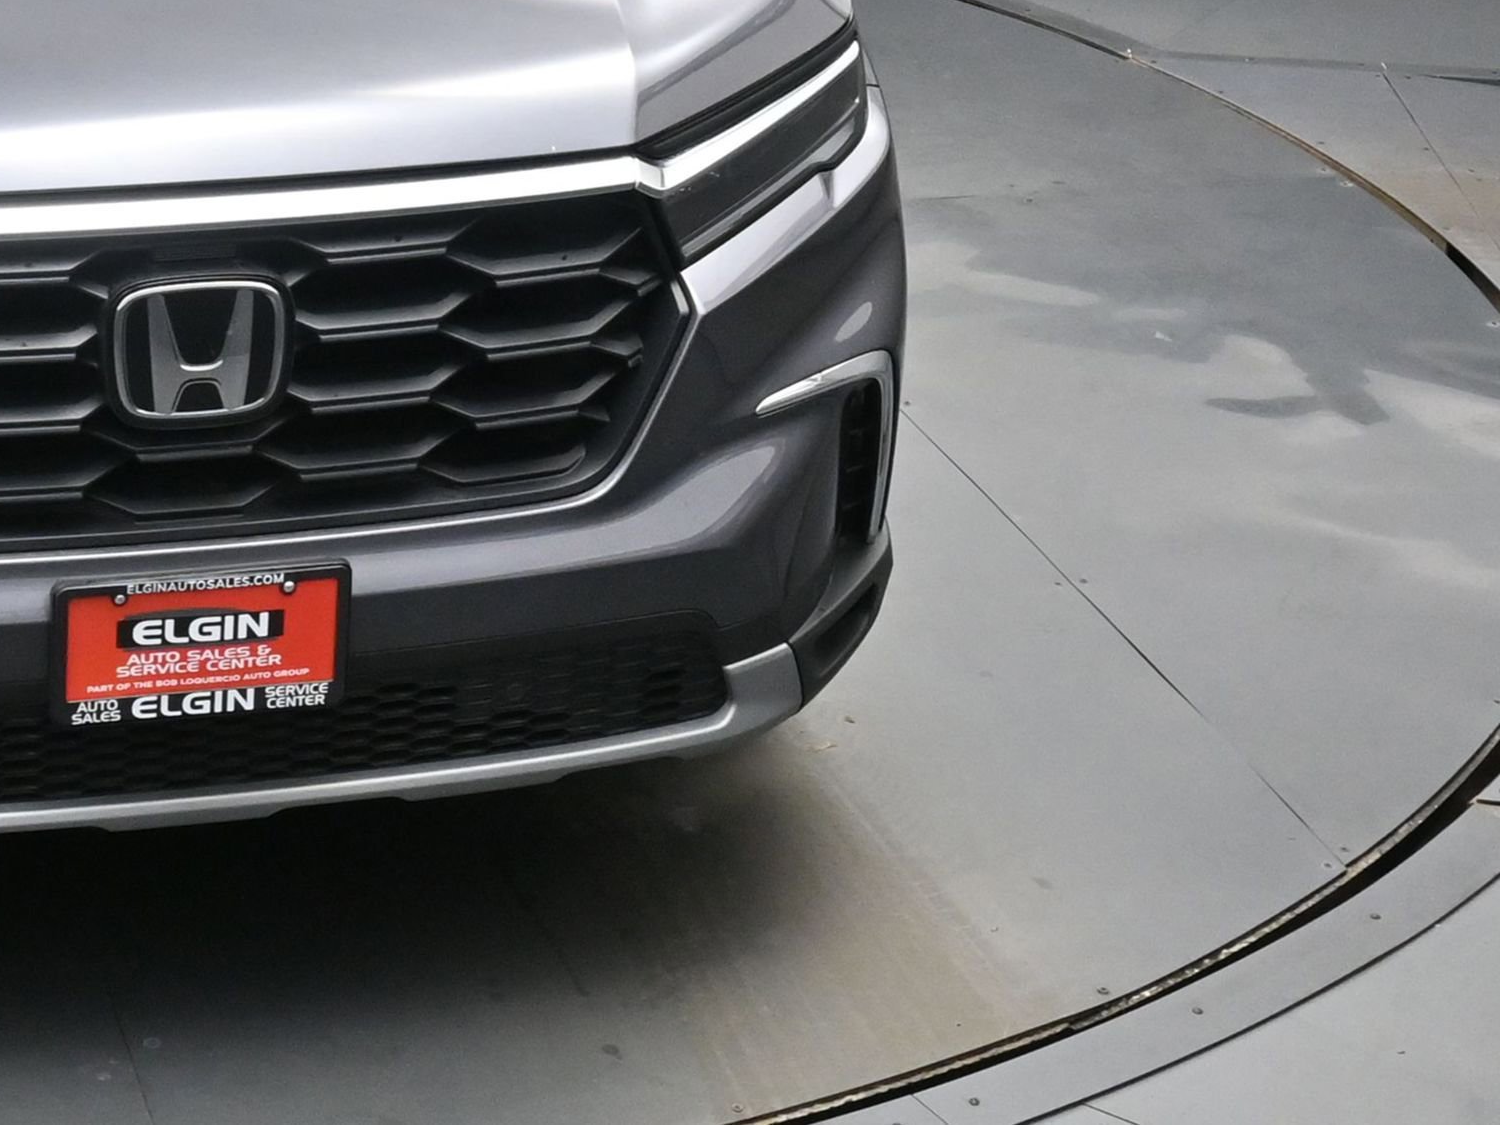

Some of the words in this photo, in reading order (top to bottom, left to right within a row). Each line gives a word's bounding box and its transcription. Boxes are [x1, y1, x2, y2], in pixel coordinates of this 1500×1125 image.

[126, 572, 285, 595] ELGINAUTOSALES.COM
[132, 611, 270, 645] ELGIN
[116, 661, 200, 678] SERVICE
[206, 654, 282, 672] CENTER
[126, 651, 180, 666] AUTO
[187, 646, 251, 662] SALES
[257, 644, 272, 656] &
[86, 684, 114, 693] PART
[116, 682, 132, 691] OF
[133, 680, 154, 689] THE
[155, 678, 178, 688] BOB
[243, 670, 271, 681] AUTO
[273, 667, 310, 678] GROUP
[265, 682, 329, 698] SERVICE
[76, 698, 119, 714] AUTO
[131, 687, 255, 720] ELGIN
[266, 694, 326, 709] CENTER
[71, 710, 122, 726] SALES
